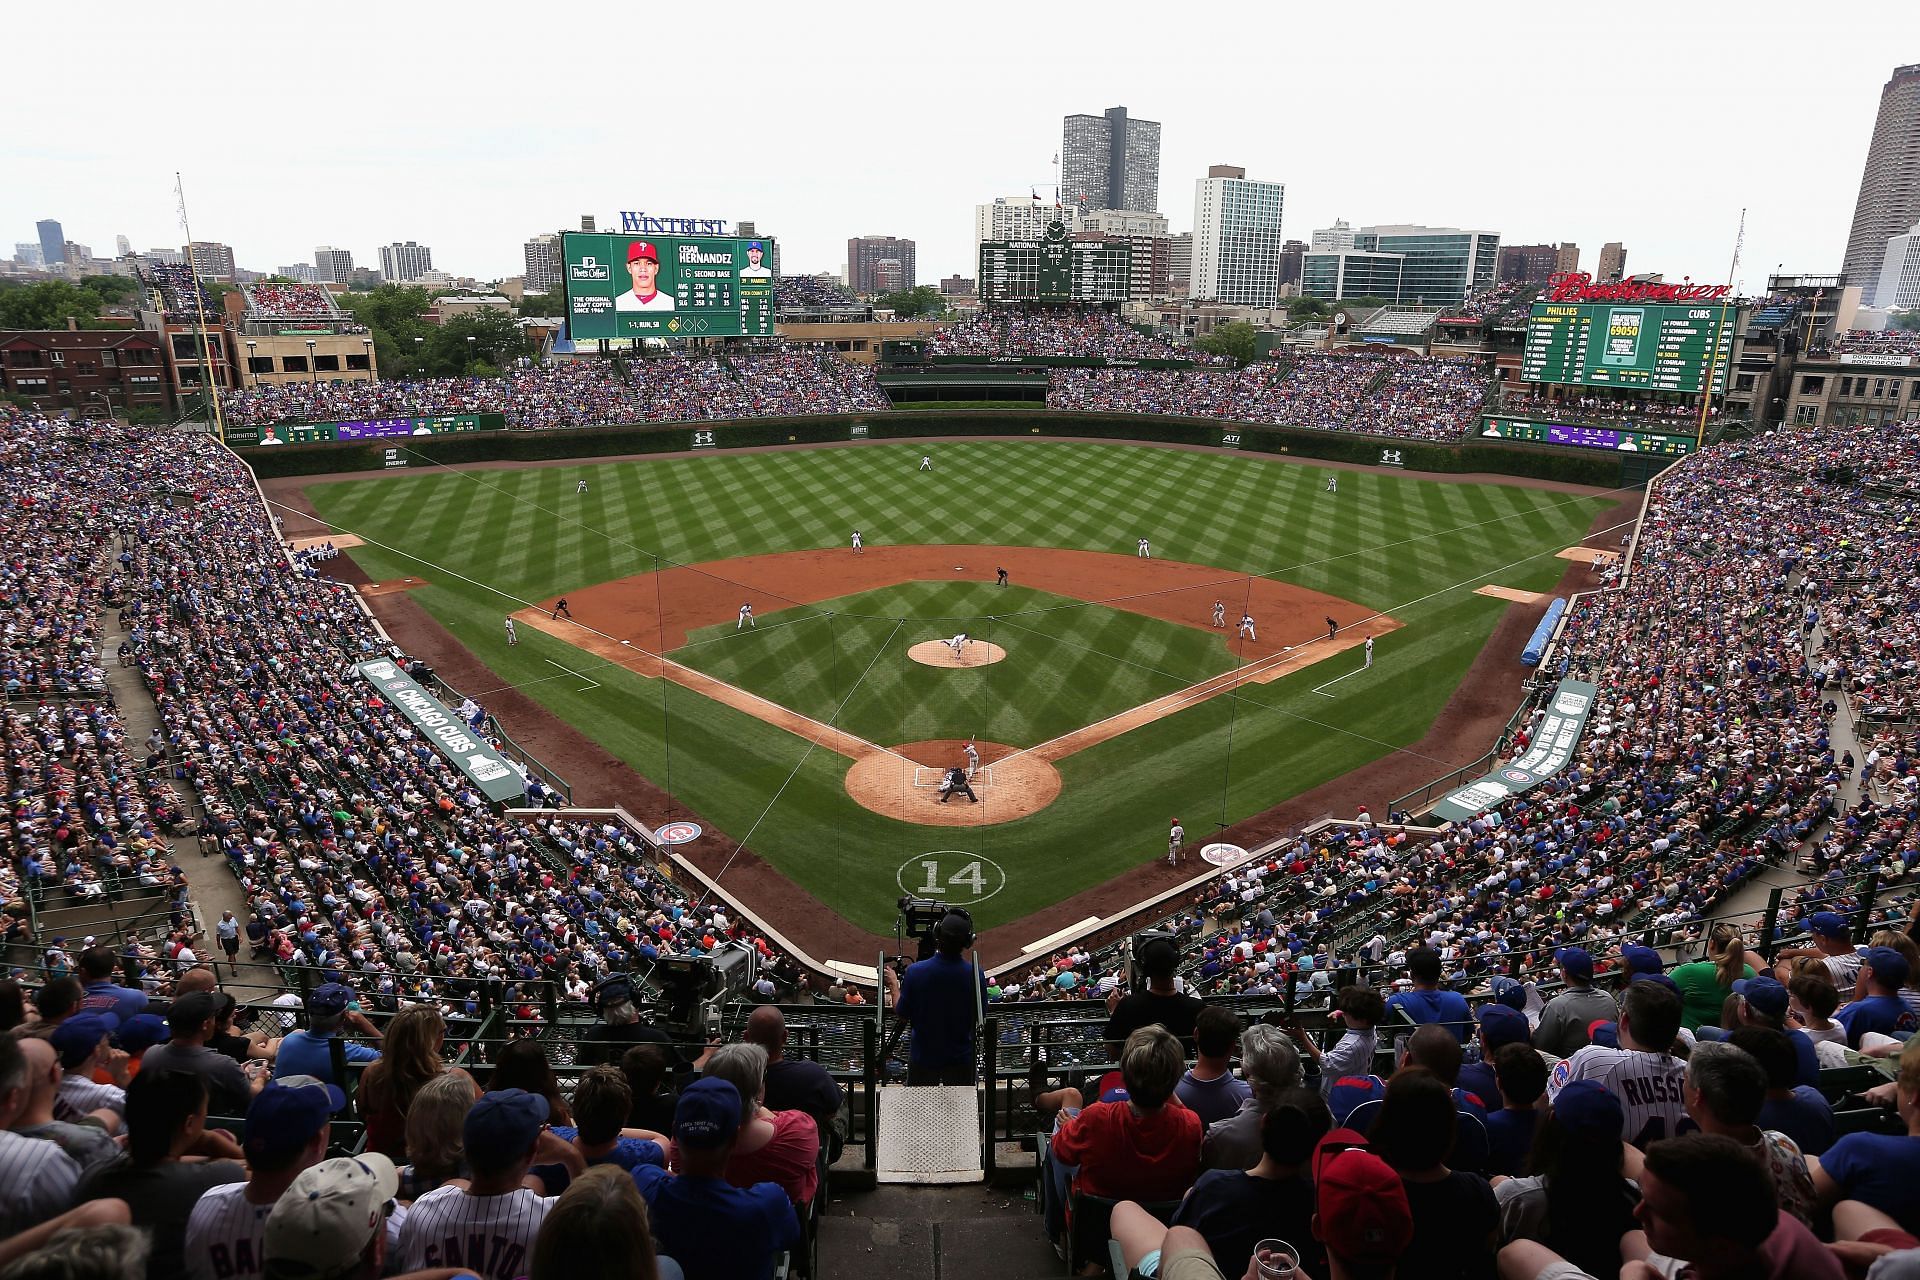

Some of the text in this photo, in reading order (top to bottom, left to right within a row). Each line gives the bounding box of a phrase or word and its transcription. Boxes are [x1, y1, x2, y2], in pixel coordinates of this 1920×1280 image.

[620, 211, 727, 235] WINTRUST
[679, 245, 698, 253] CESAR
[679, 253, 732, 264] HERNANDEZ
[588, 268, 606, 279] Coffee
[680, 269, 731, 278] 16 SECOND BASE
[1548, 272, 1733, 301] Budweiser
[1546, 306, 1578, 316] PHILLIES
[1688, 310, 1710, 319] CUBS
[1610, 326, 1638, 336] 69050
[228, 432, 258, 440] HORNITOS
[1222, 434, 1240, 442] ATI
[396, 690, 478, 753] CHICAGO CUBS
[919, 860, 987, 895] 14
[210, 1238, 264, 1280] BA
